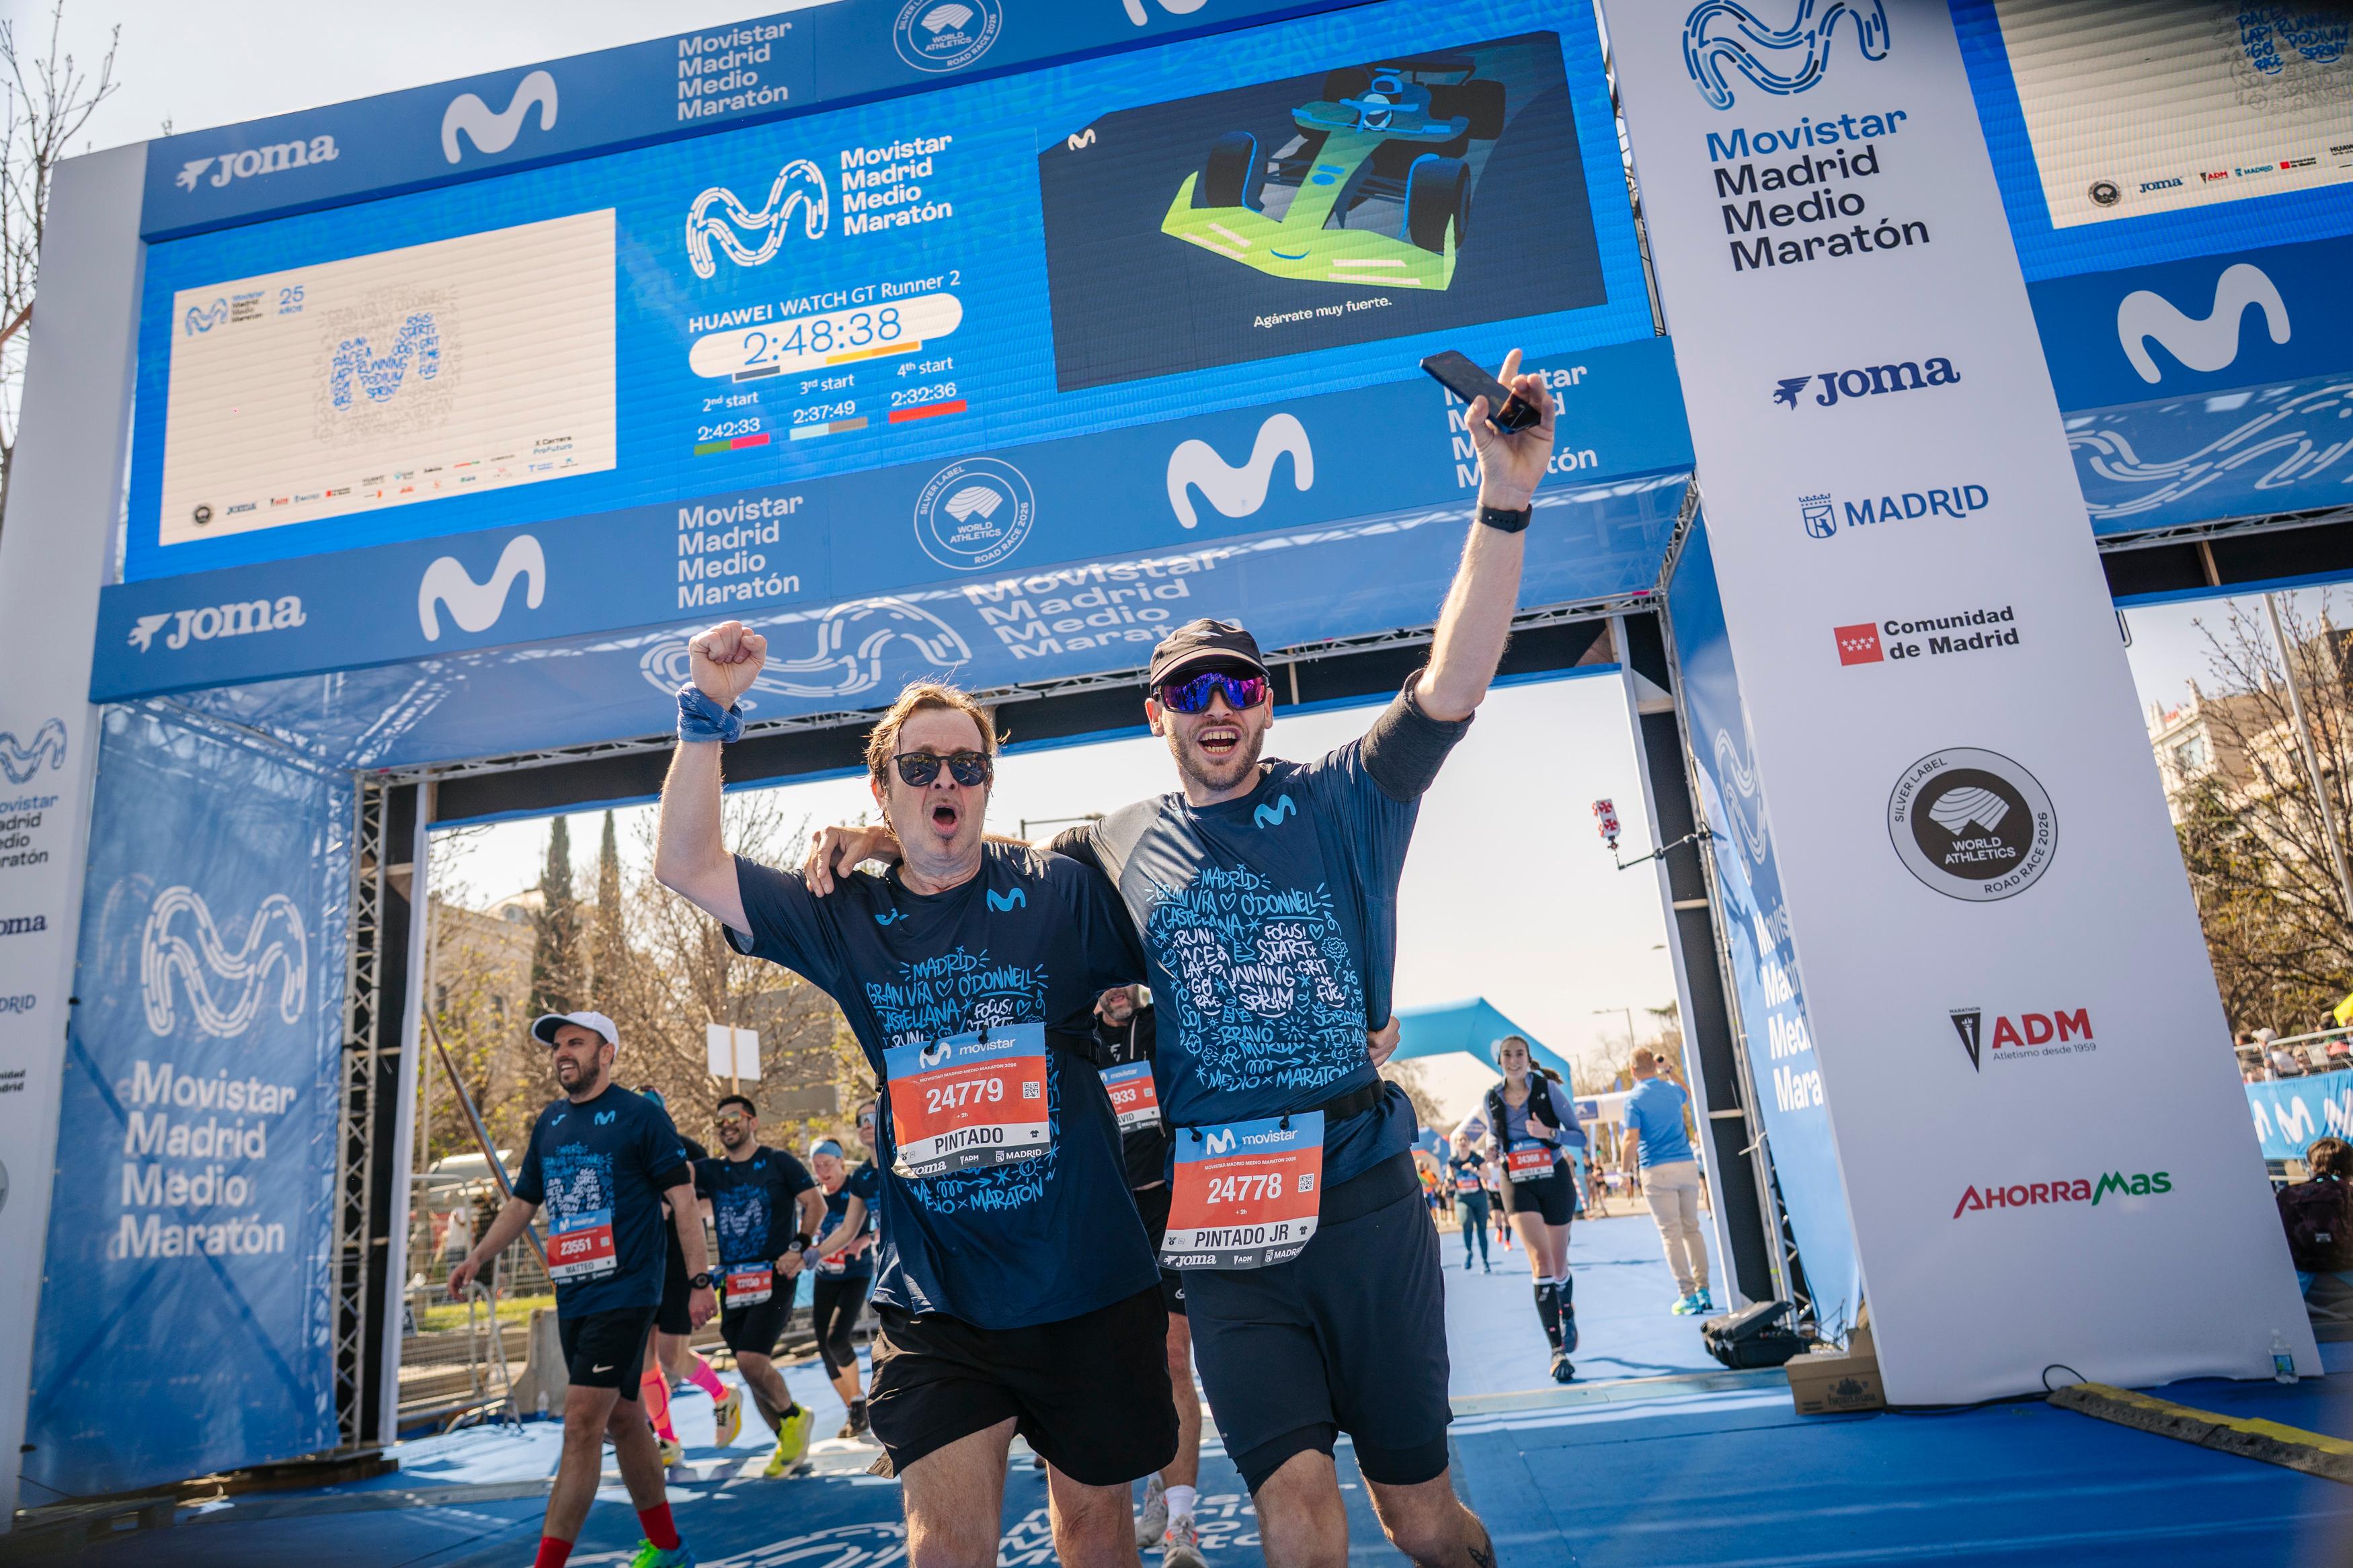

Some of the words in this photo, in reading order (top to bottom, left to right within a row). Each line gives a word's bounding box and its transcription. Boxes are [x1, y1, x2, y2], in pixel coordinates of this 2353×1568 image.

[899, 5, 916, 30] SILVER
[678, 19, 793, 58] Movistar
[925, 37, 971, 51] ATHLETICS
[932, 32, 964, 43] WORLD
[947, 53, 971, 67] ROAD
[971, 36, 990, 54] RACE
[986, 13, 997, 34] 2026
[678, 44, 770, 79] Madrid
[678, 69, 758, 99] Medio
[678, 83, 789, 121] Maratón
[1706, 109, 1907, 162] Movistar
[841, 134, 953, 169] Movistar
[841, 158, 933, 192] Madrid
[1714, 145, 1880, 198] Madrid
[842, 184, 922, 214] Medio
[1722, 188, 1865, 235] Medio
[844, 199, 953, 237] Maratón
[1730, 218, 1929, 272] Maratón
[279, 285, 305, 305] 25
[689, 305, 772, 333] HUAWEI
[779, 292, 847, 317] WATCH
[851, 284, 877, 302] GT
[881, 276, 945, 298] Runner
[949, 270, 961, 286] 2
[1254, 308, 1313, 328] Agárrate
[1316, 302, 1344, 318] muy
[1345, 296, 1392, 314] fuerte.
[744, 308, 902, 366] 2:48:38
[897, 362, 916, 378] 4th
[918, 356, 954, 374] start
[800, 378, 819, 395] 3rd
[821, 374, 855, 390] start
[891, 382, 957, 407] 2:32:36
[703, 396, 723, 413] 2nd
[726, 391, 759, 408] start
[793, 401, 856, 424] 2:37:49
[697, 417, 760, 440] 2:42:33
[920, 485, 938, 515] SILVER
[936, 466, 965, 485] LABEL
[1843, 484, 1989, 527] MADRID
[678, 493, 803, 532] Movistar
[957, 522, 992, 534] WORLD
[678, 520, 779, 556] Madrid
[950, 528, 1001, 543] ATHLETICS
[975, 548, 1001, 564] ROAD
[1001, 528, 1022, 550] RACE
[1018, 502, 1029, 528] 2026
[678, 552, 766, 583] Medio
[961, 550, 1230, 606] Movistar
[678, 573, 800, 609] Maratón
[978, 578, 1191, 626] Madrid
[994, 604, 1170, 644] Medio
[1884, 606, 2015, 636] Comunidad
[1889, 641, 1921, 660] de
[1929, 628, 2020, 655] Madrid
[1895, 782, 1914, 823] SILVER
[1910, 757, 1948, 783] LABEL
[1945, 846, 2016, 864] ATHLETICS
[1952, 837, 2001, 852] WORLD
[1985, 874, 2020, 893] ROAD
[2020, 848, 2045, 878] RACE
[2038, 812, 2049, 845] 2026
[1201, 866, 1260, 891] MADRID
[1156, 881, 1188, 907] GRAN
[1241, 888, 1321, 915] O'DONNELL
[1264, 921, 1306, 940] FOCUS!
[913, 946, 978, 980] MADRID
[1257, 939, 1312, 965] START
[866, 983, 903, 1007] GRAN
[959, 964, 1037, 997] O'DONNELL
[1343, 970, 1358, 985] 26
[974, 998, 1013, 1019] FOCUS!
[1182, 1005, 1209, 1033] SOL
[1949, 1006, 1981, 1014] MARATHON
[1218, 1025, 1274, 1044] BRAVO
[1992, 1008, 2093, 1049] ADM
[959, 1038, 1016, 1055] movistar
[1993, 1050, 2040, 1061] Atletismo
[2042, 1046, 2071, 1056] desde
[2075, 1042, 2096, 1053] 1959
[131, 1060, 296, 1114] Movistar
[920, 1074, 943, 1083] MOVISTAR
[944, 1070, 963, 1079] MADRID
[963, 1067, 979, 1075] MEDIO
[980, 1063, 1004, 1073] MARATÓN
[1208, 1069, 1260, 1091] MEDIO
[926, 1077, 1003, 1114] 24779
[124, 1110, 266, 1159] Madrid
[935, 1127, 1003, 1155] PINTADO
[1242, 1129, 1298, 1145] movistar
[1006, 1149, 1041, 1160] MADRID
[121, 1161, 249, 1207] Medio
[1207, 1173, 1282, 1204] 24778
[118, 1212, 285, 1259] Maratón
[561, 1237, 592, 1256] 23551
[1195, 1227, 1265, 1247] PINTADO
[1270, 1224, 1288, 1241] JR
[565, 1262, 594, 1275] MATTEO
